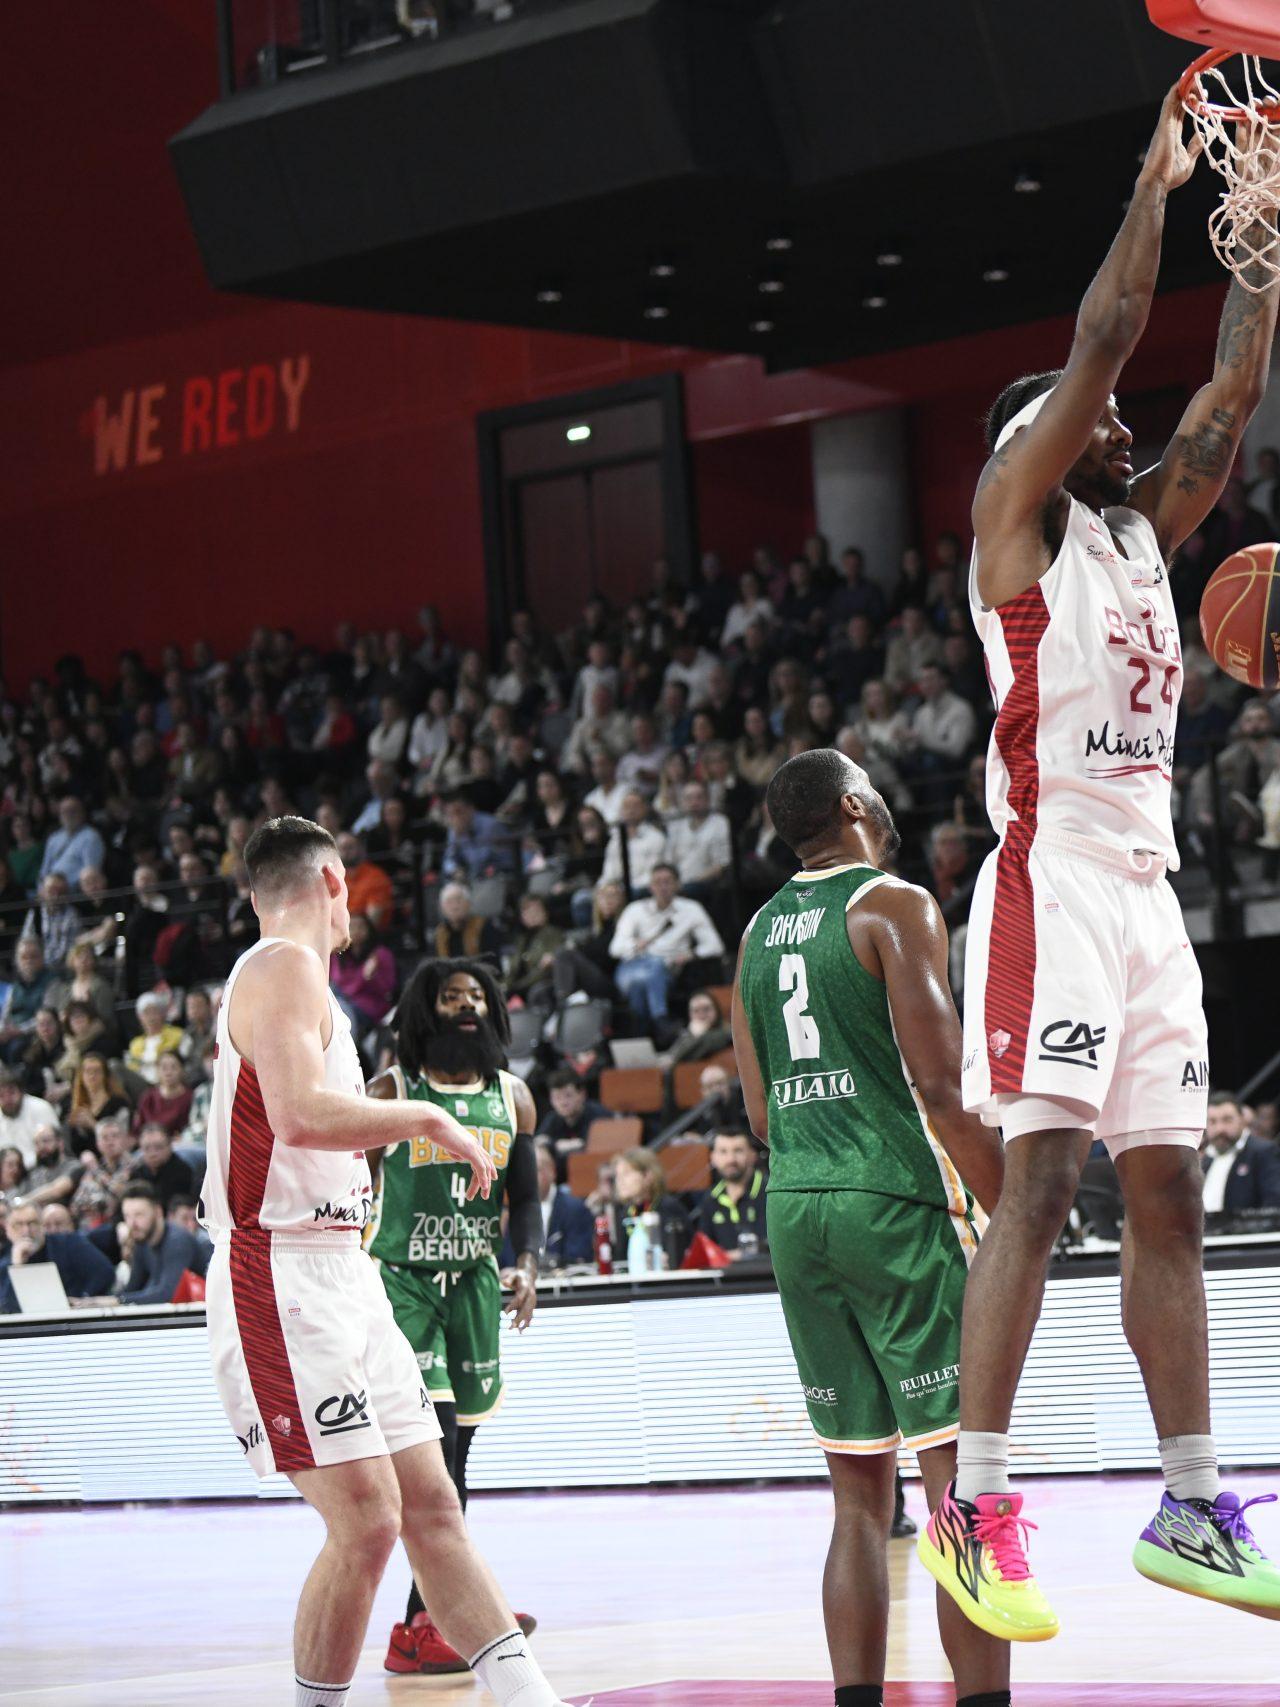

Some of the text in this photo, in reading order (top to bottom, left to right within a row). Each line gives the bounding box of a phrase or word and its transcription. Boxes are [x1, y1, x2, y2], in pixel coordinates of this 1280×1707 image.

[94, 353, 311, 476] WE REDY
[778, 953, 821, 1062] 2
[409, 1126, 512, 1169] BLIS
[451, 1172, 467, 1208] 4
[408, 1238, 493, 1261] BEAUVAL
